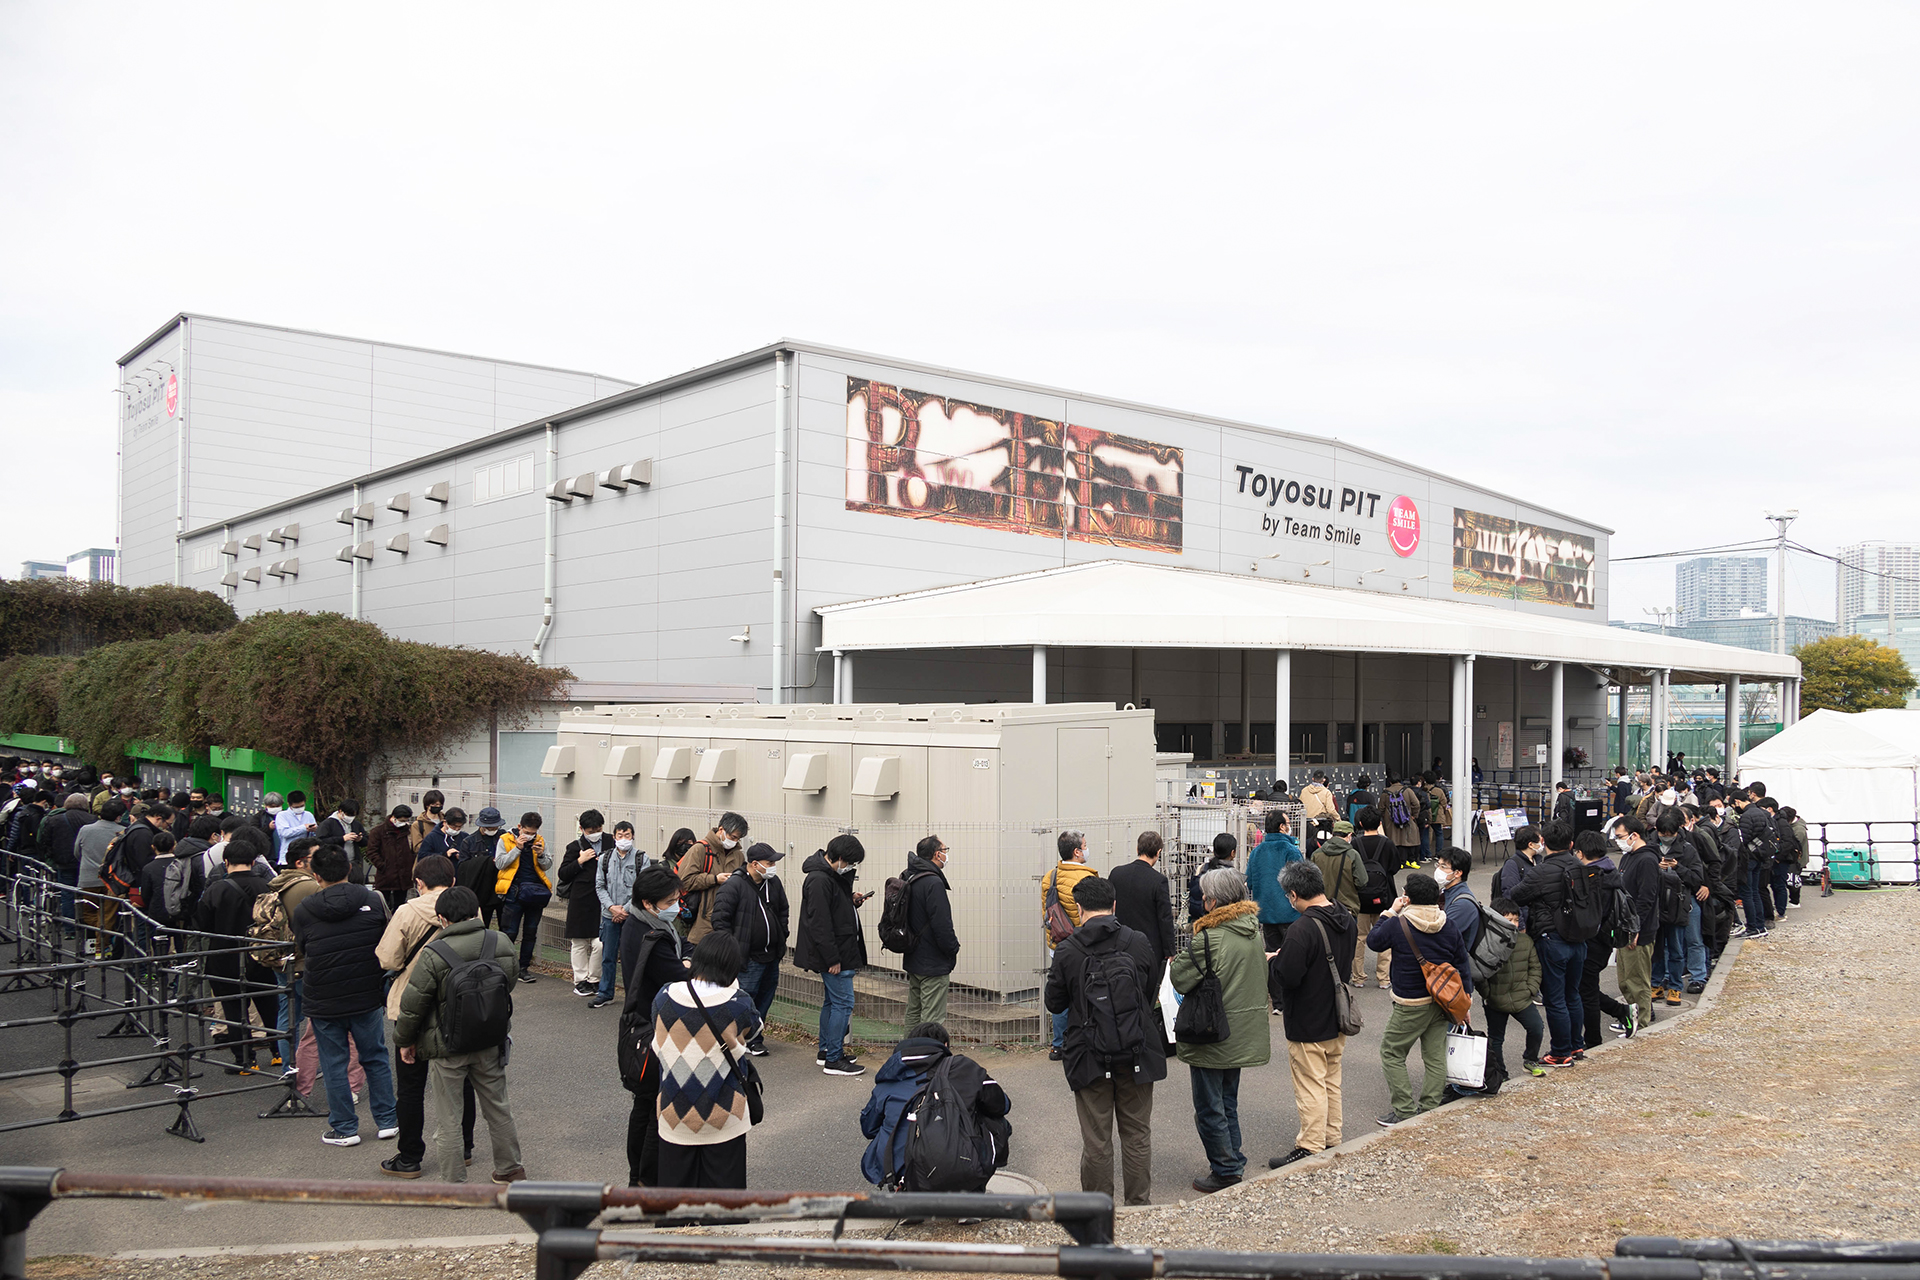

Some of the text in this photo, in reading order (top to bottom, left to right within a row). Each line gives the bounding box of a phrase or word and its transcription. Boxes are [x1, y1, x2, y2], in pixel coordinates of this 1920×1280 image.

[1235, 464, 1381, 518] Toyosu PIT
[1392, 507, 1416, 521] TEAM
[1392, 517, 1416, 530] SMILE
[1262, 512, 1361, 546] by Team Smile
